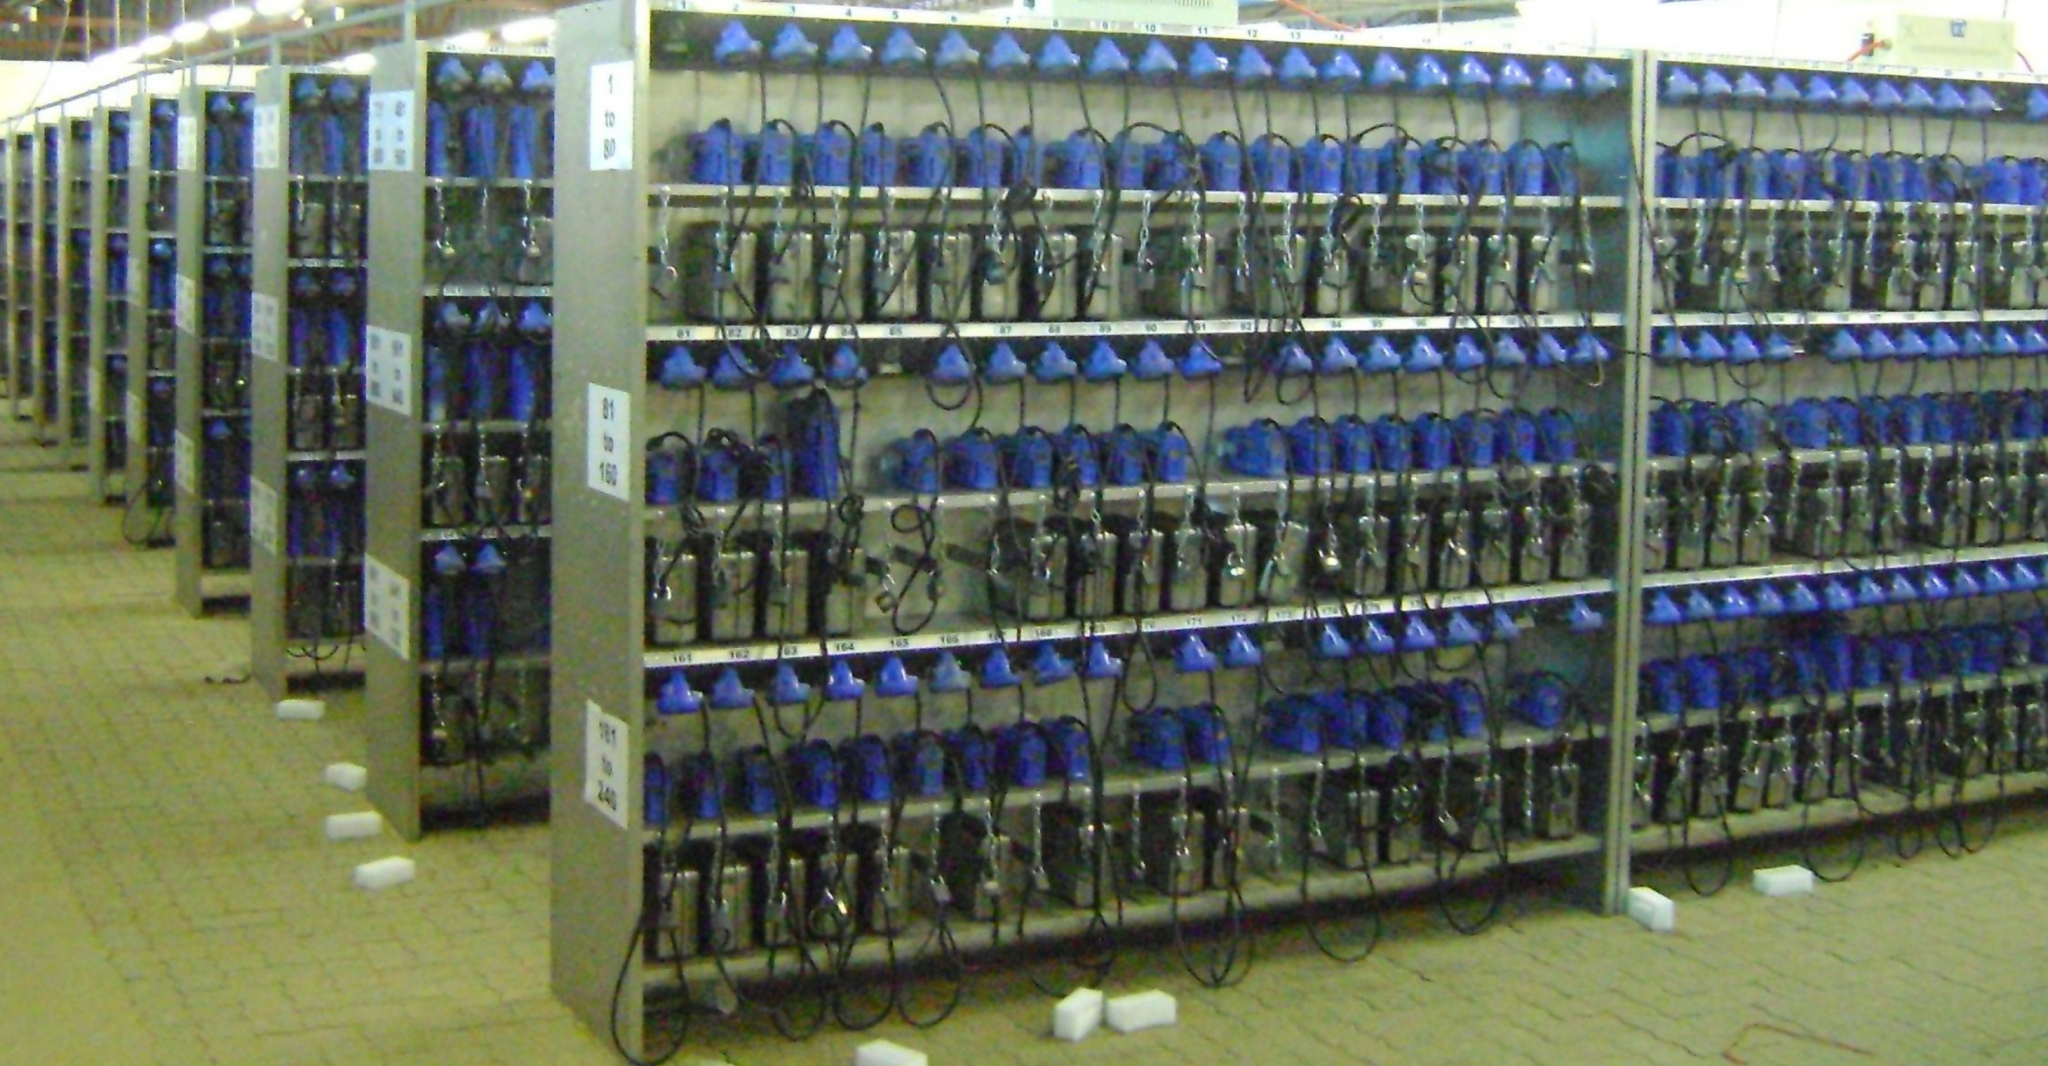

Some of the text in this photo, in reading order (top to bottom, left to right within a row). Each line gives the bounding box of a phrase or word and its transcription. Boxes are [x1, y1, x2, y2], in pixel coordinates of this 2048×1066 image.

[732, 3, 739, 12] 2
[789, 5, 797, 14] 3
[845, 9, 852, 17] 4
[892, 11, 899, 20] 5
[951, 15, 958, 23] 6
[1005, 16, 1011, 25] 7
[1052, 20, 1059, 29] 8
[1101, 21, 1109, 30] 9
[1145, 23, 1157, 33] 10
[1197, 27, 1208, 35] 11
[1247, 29, 1258, 38] 12
[1290, 32, 1301, 41] 13
[608, 74, 613, 94] 1
[604, 109, 616, 128] to
[603, 137, 616, 160] 80
[786, 328, 800, 337] 83
[999, 325, 1012, 335] 87
[602, 397, 614, 421] 81
[603, 433, 614, 453] to
[599, 462, 618, 487] 160
[673, 653, 692, 664] 161
[730, 649, 749, 660] 162
[836, 642, 855, 652] 164
[891, 637, 909, 648] 165
[1186, 616, 1203, 626] 171
[597, 780, 617, 811] 240
